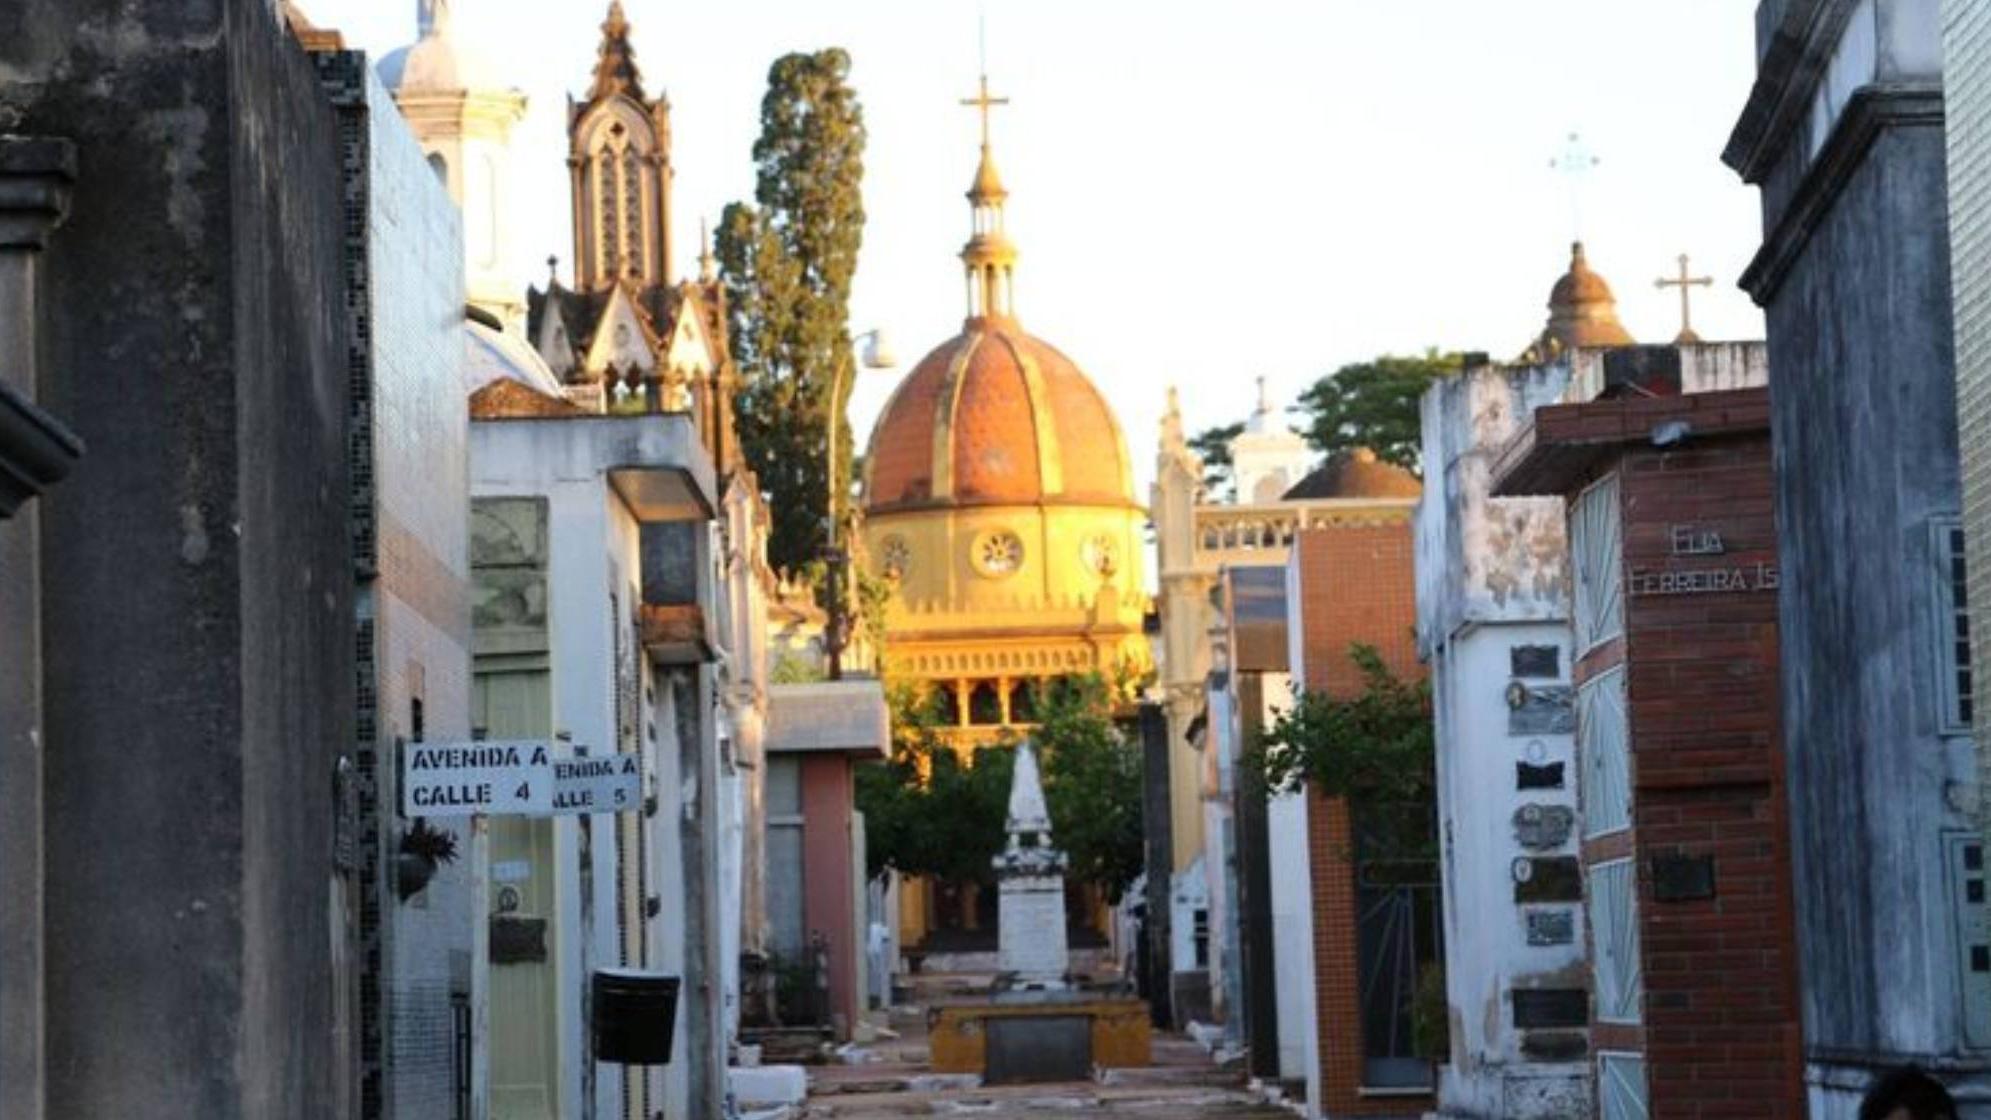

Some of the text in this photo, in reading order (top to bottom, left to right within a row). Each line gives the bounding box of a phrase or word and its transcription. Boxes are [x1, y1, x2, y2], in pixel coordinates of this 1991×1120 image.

[1629, 565, 1748, 595] FERREIRA
[412, 746, 549, 770] AVENIDA A
[622, 758, 637, 774] A
[413, 782, 530, 806] CALLE 4
[614, 788, 627, 804] 5
